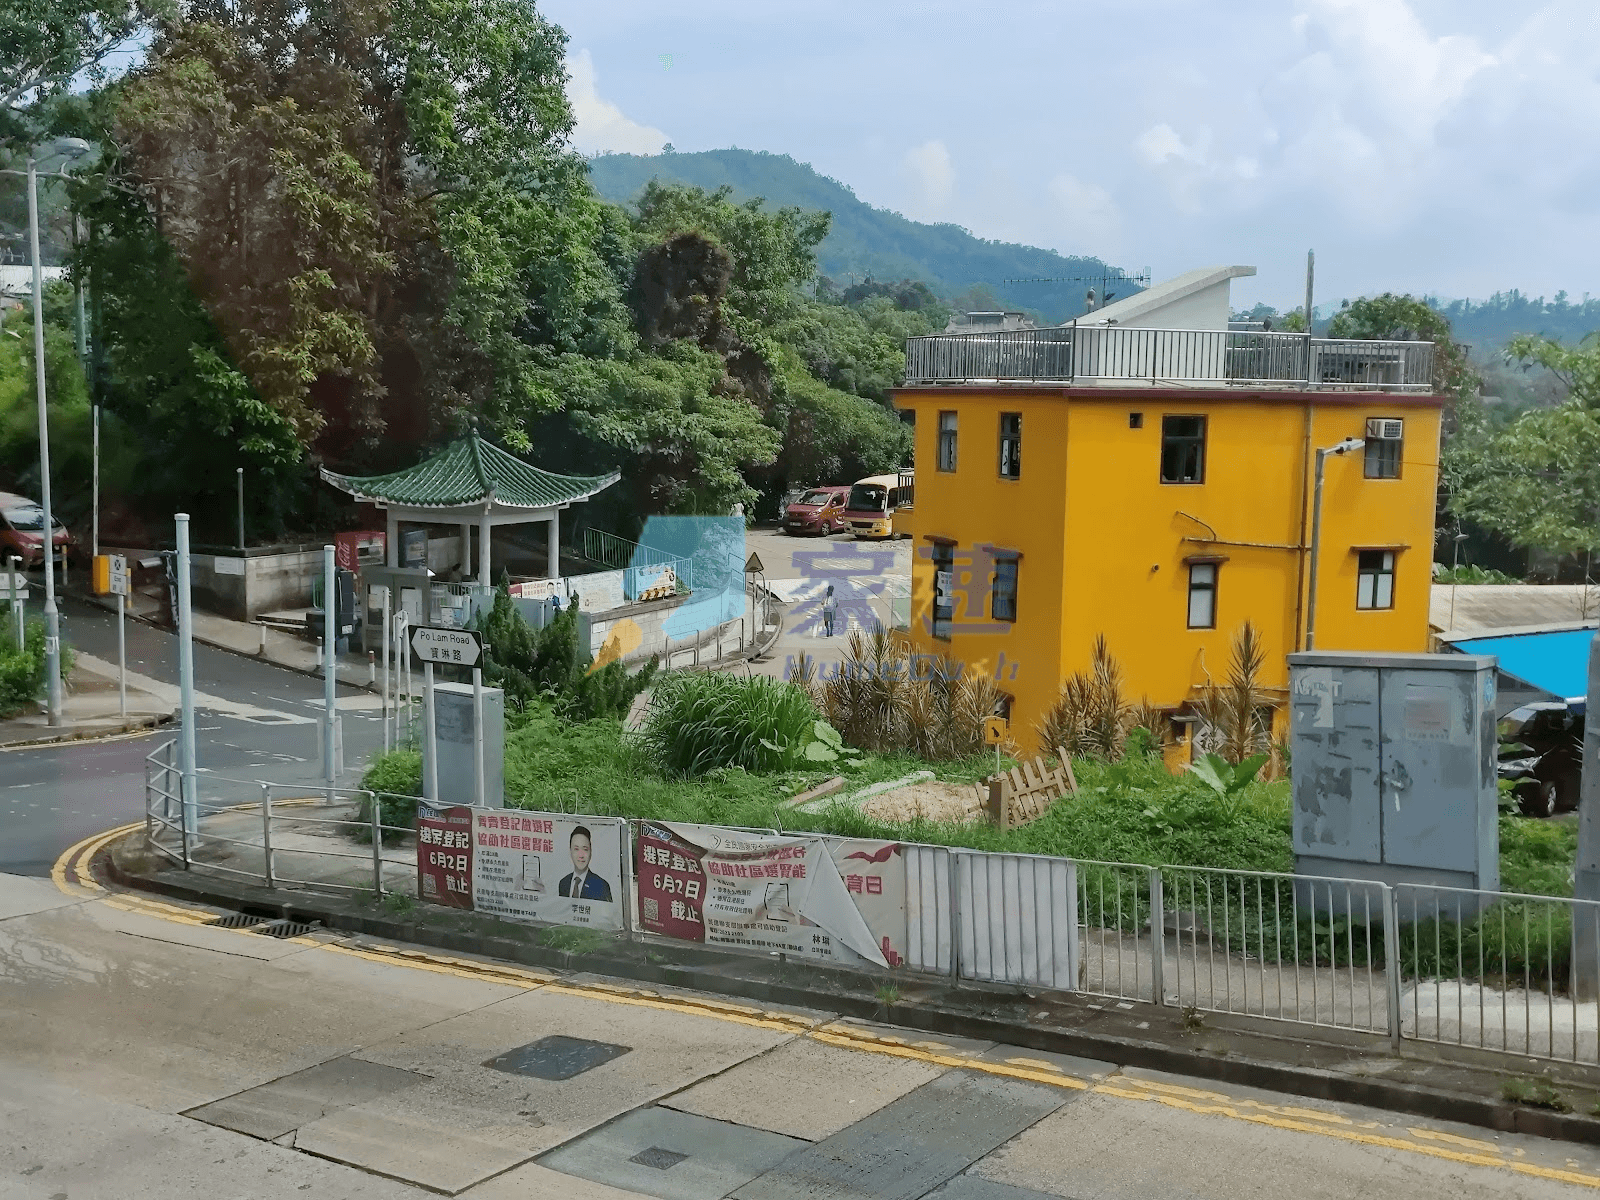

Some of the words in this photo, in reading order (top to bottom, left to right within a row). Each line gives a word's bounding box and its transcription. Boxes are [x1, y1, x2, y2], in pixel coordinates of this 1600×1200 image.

[420, 631, 430, 641] Po
[432, 633, 449, 643] Lam
[450, 634, 470, 645] Road
[430, 647, 462, 662] 寶琳路
[419, 825, 469, 849] 選民登記
[477, 832, 554, 853] 協助社區選賢能
[429, 851, 468, 872] 6月2日
[643, 844, 701, 874] 選民登記
[708, 861, 806, 879] 協助社區選賢能
[445, 873, 469, 894] 截止
[653, 873, 700, 900] 6月2日
[841, 874, 882, 895] 育日
[671, 900, 700, 923] 截止
